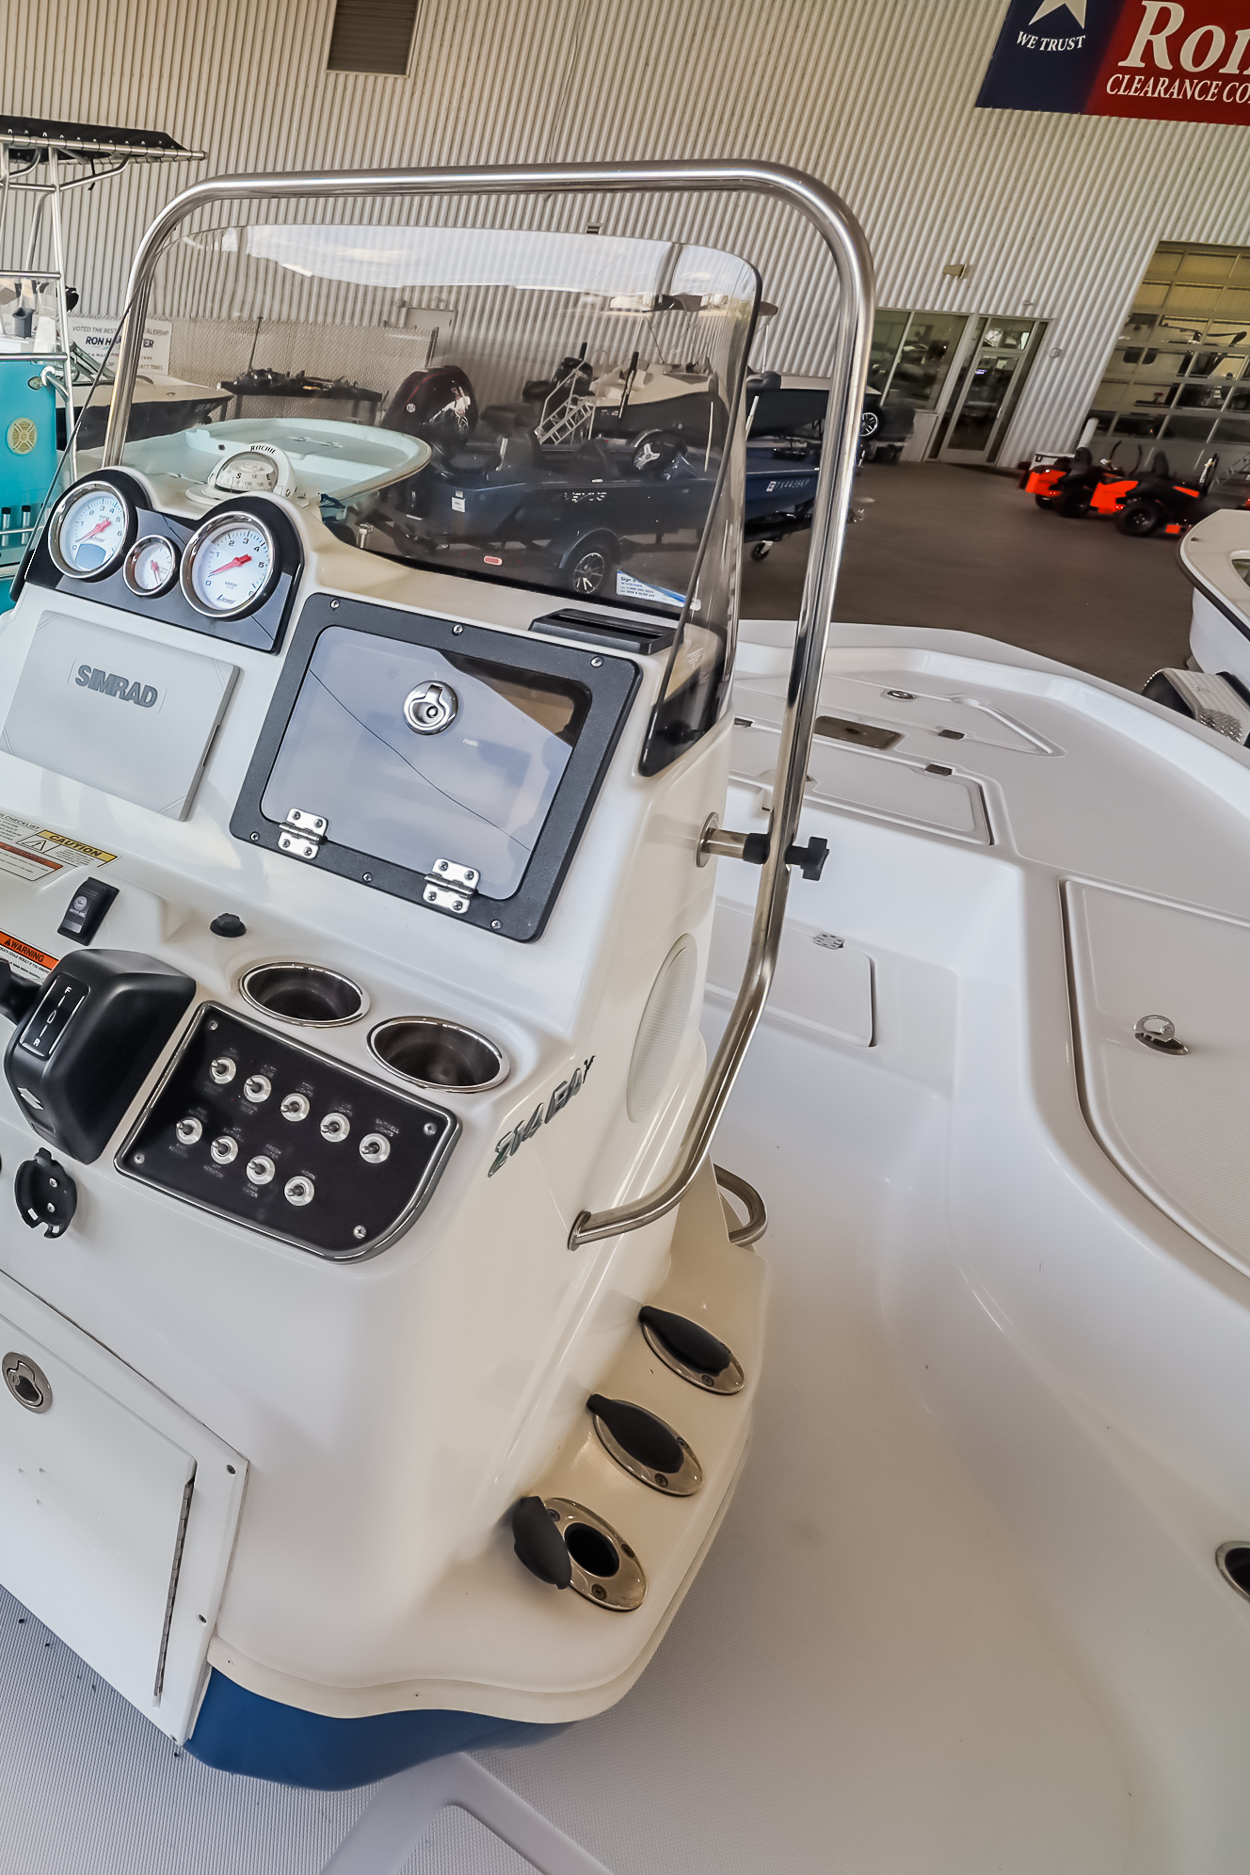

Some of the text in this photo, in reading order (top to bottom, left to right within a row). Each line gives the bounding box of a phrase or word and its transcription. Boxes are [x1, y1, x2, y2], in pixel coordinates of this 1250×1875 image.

[1016, 31, 1086, 52] WE TRUST
[1106, 73, 1250, 104] CLEARANCE CO
[85, 336, 104, 345] RON
[75, 664, 158, 708] SIMRAD
[4, 815, 41, 831] CHECKLIST
[49, 834, 103, 859] CAUTION
[10, 940, 45, 963] WARNING
[64, 986, 72, 994] F
[32, 1038, 41, 1047] R
[544, 1055, 597, 1125] BAY
